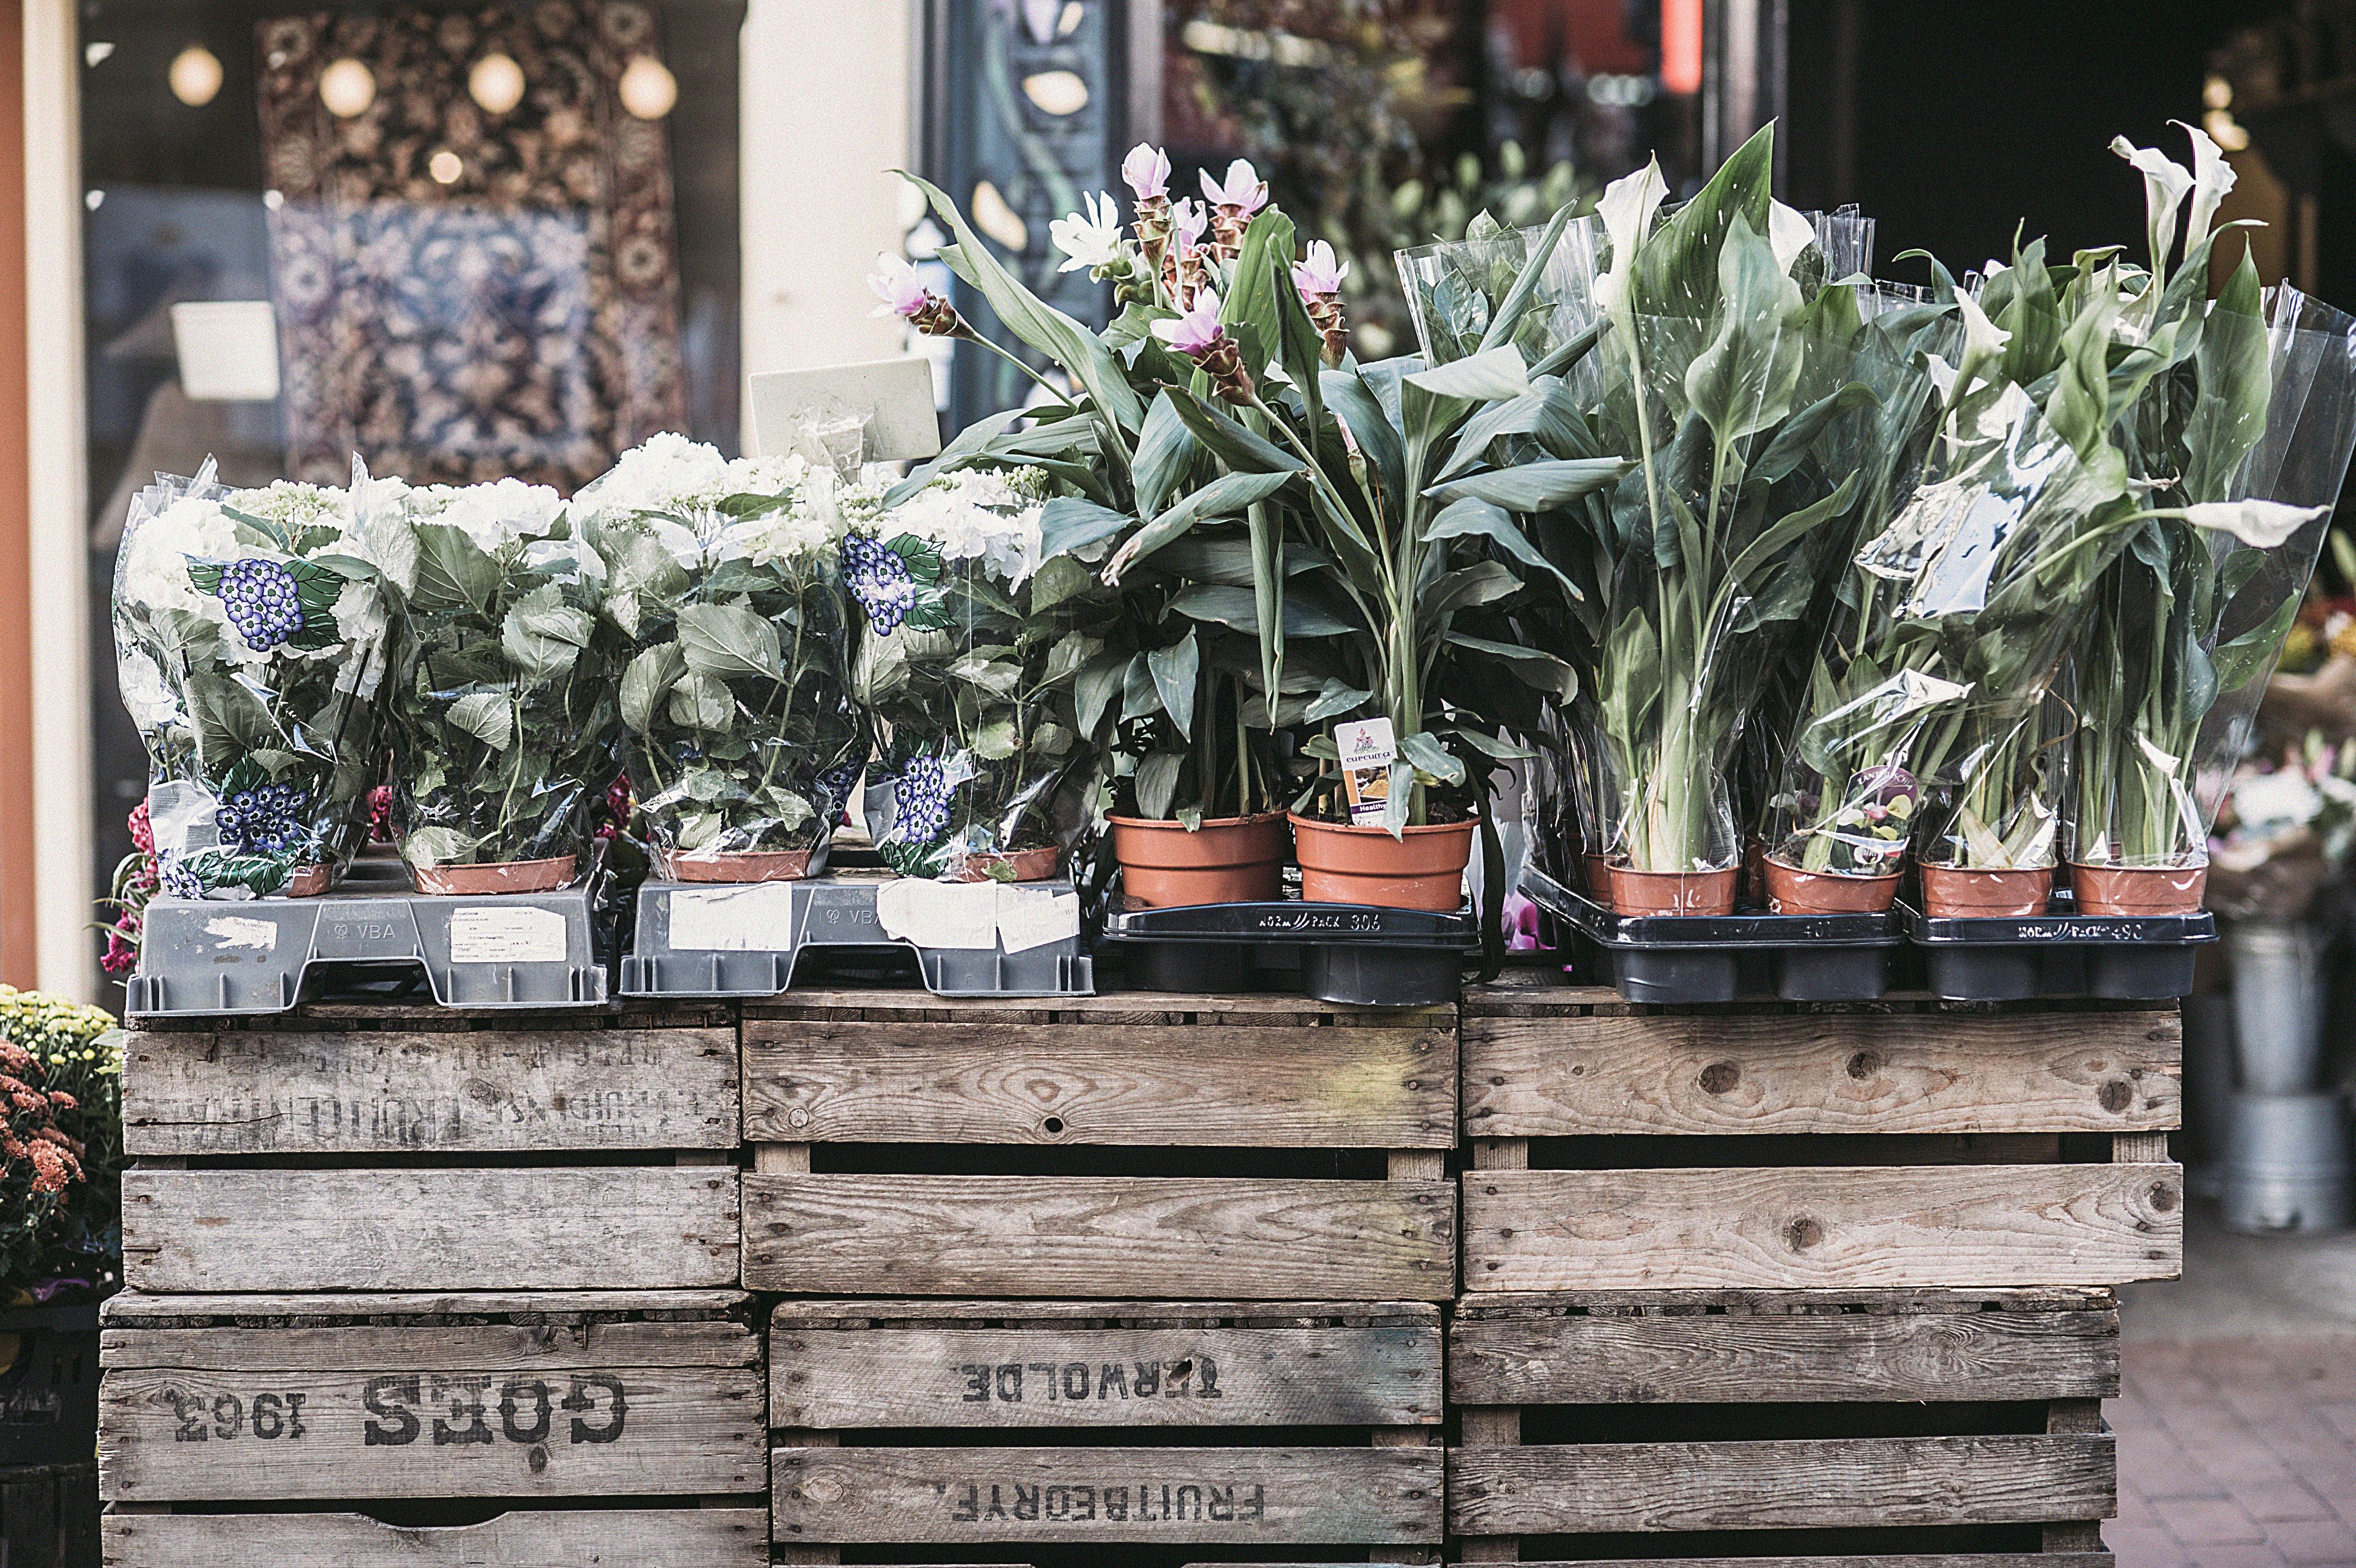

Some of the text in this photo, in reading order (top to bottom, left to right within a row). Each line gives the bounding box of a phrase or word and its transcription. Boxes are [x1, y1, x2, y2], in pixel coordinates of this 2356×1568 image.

[1359, 803, 1387, 812] Healthy
[1350, 914, 1380, 931] 306
[357, 924, 396, 940] VBA
[960, 1357, 1222, 1402] TERWOLDE
[173, 1373, 629, 1446] GOES 1963
